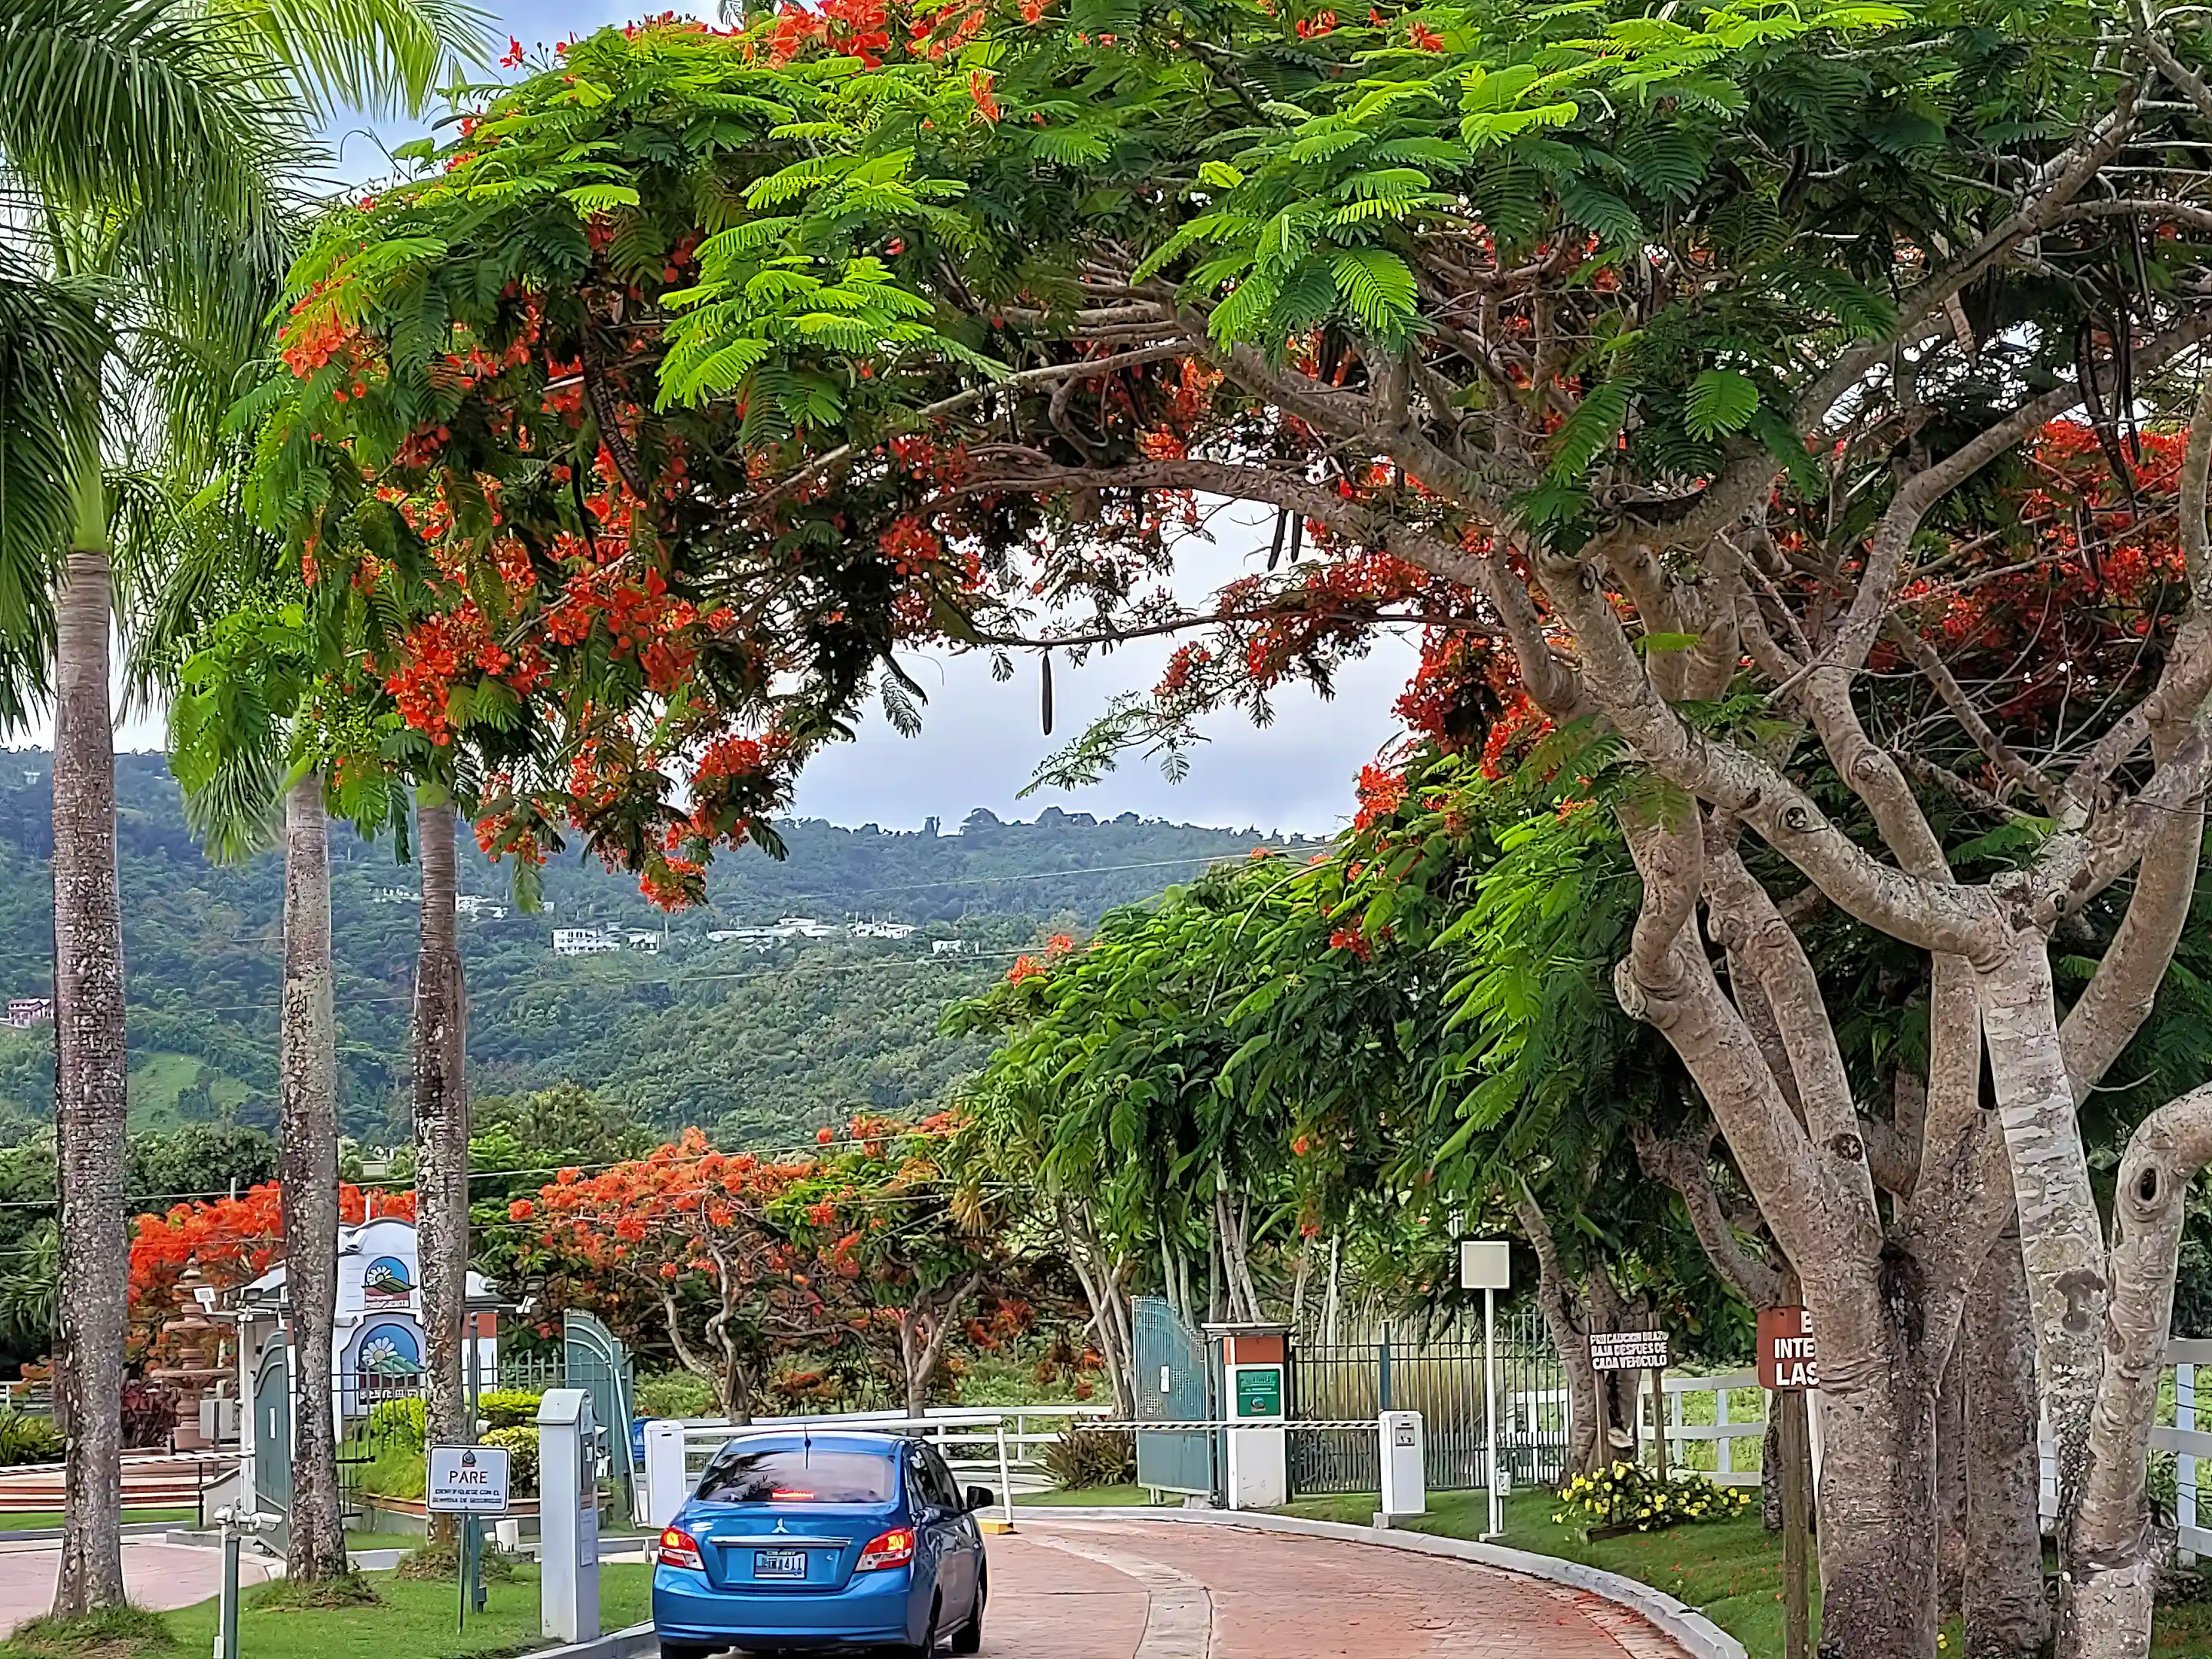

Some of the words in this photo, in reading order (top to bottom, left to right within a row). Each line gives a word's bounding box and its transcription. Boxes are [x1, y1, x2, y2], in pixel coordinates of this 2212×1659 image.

[1654, 1342, 1667, 1354] DE
[1592, 1356, 1619, 1370] CADA
[1776, 1361, 1820, 1386] LAS
[449, 1471, 488, 1484] PARE
